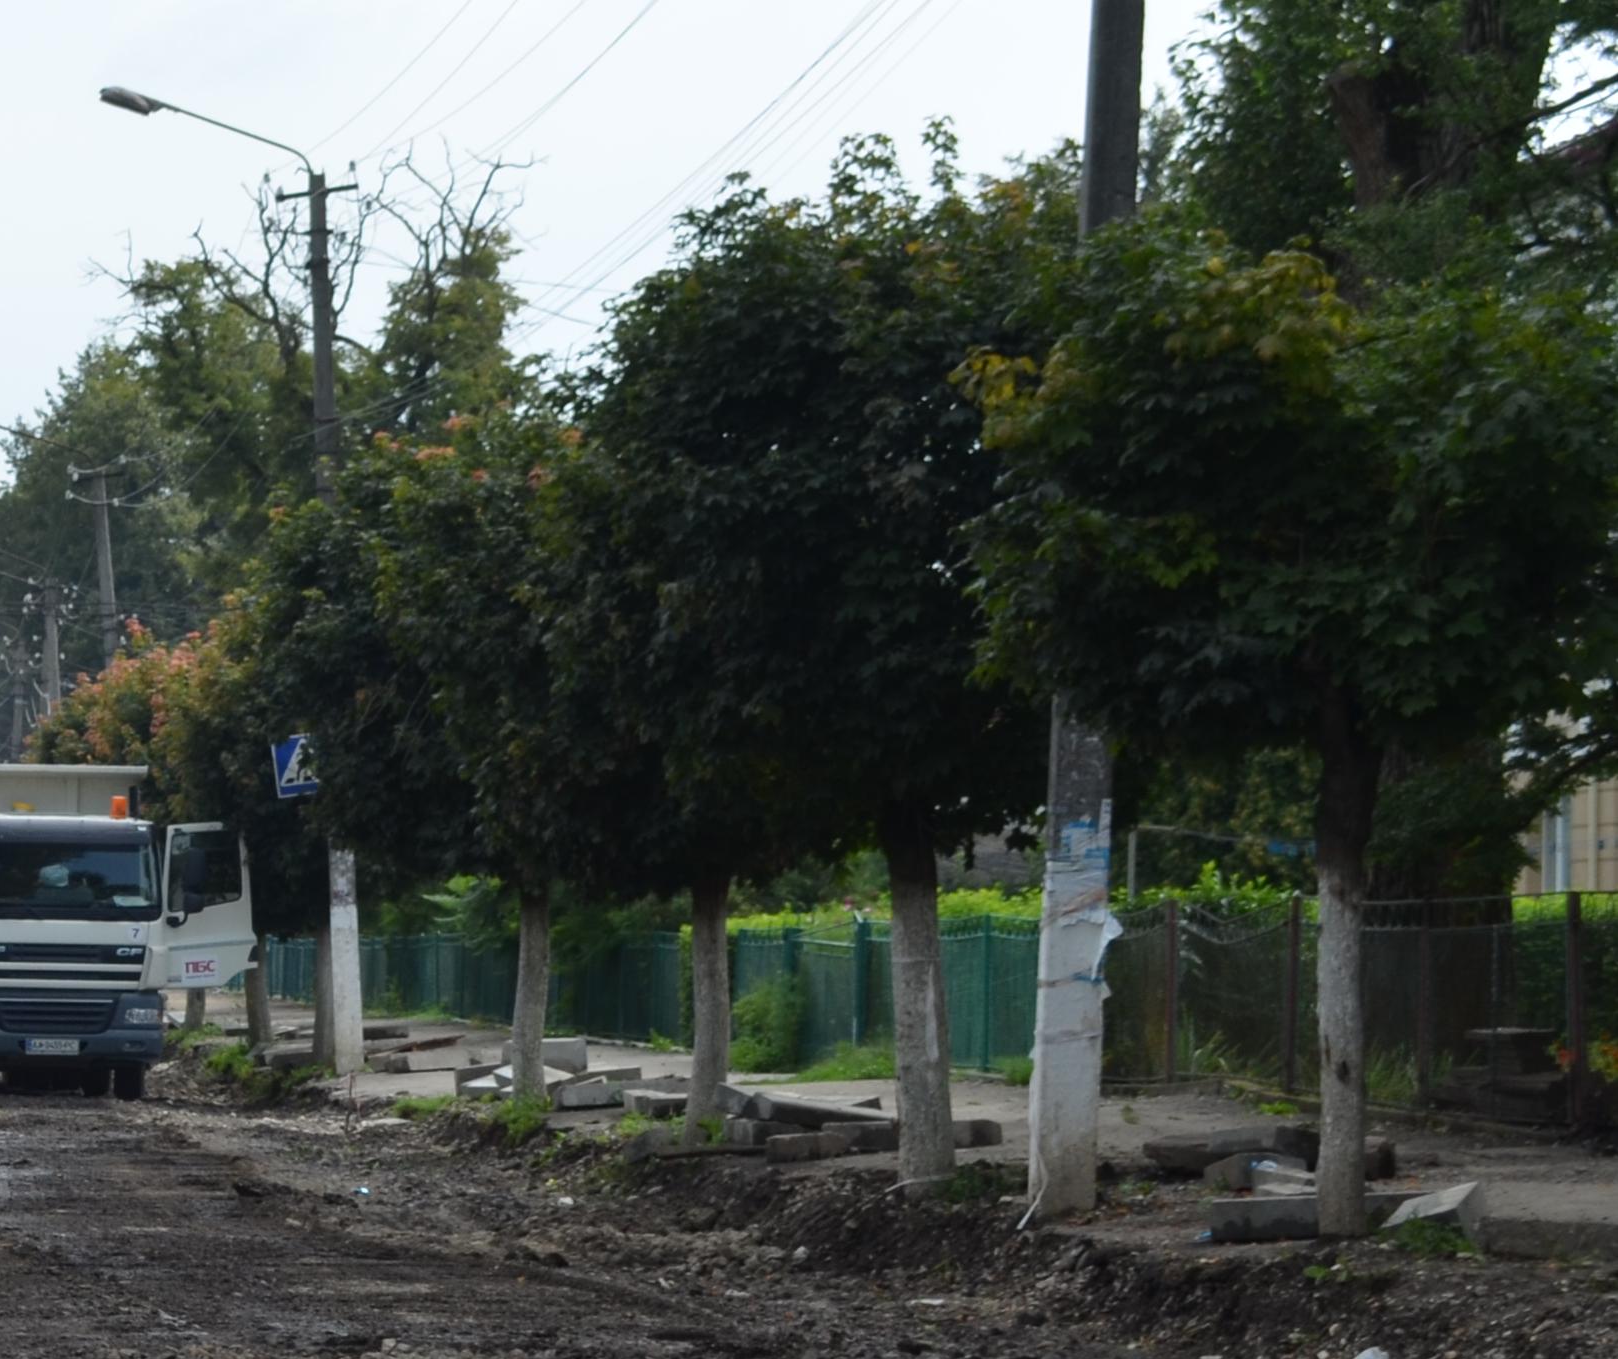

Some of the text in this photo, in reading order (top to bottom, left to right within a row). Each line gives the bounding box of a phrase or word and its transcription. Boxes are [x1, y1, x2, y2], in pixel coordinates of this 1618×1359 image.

[132, 928, 140, 938] 7
[116, 948, 143, 956] CF
[185, 960, 215, 973] ПБС
